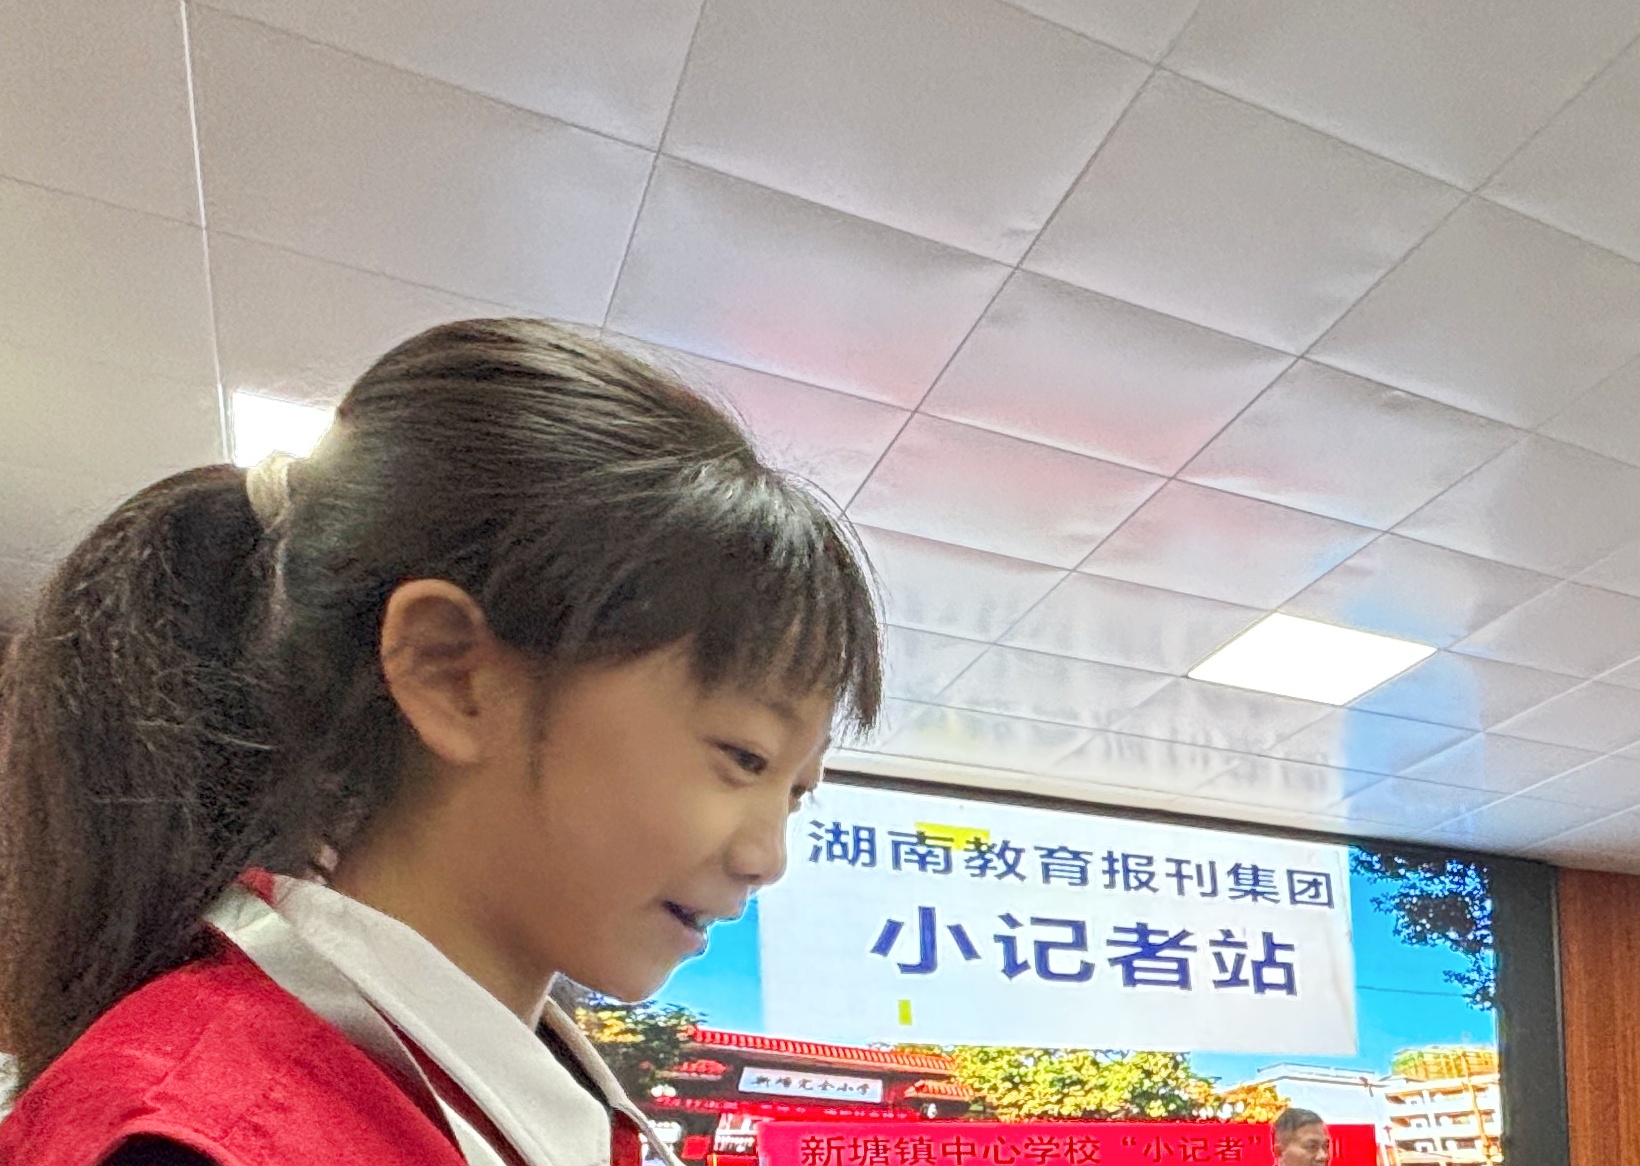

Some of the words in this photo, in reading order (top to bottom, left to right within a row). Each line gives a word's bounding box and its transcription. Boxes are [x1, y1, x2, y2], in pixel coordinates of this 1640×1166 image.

[808, 819, 1335, 908] 湖南教育报刊集团
[870, 905, 1299, 996] 小记者站
[800, 1135, 1344, 1166] 新塘镇中心学校“小记者”
